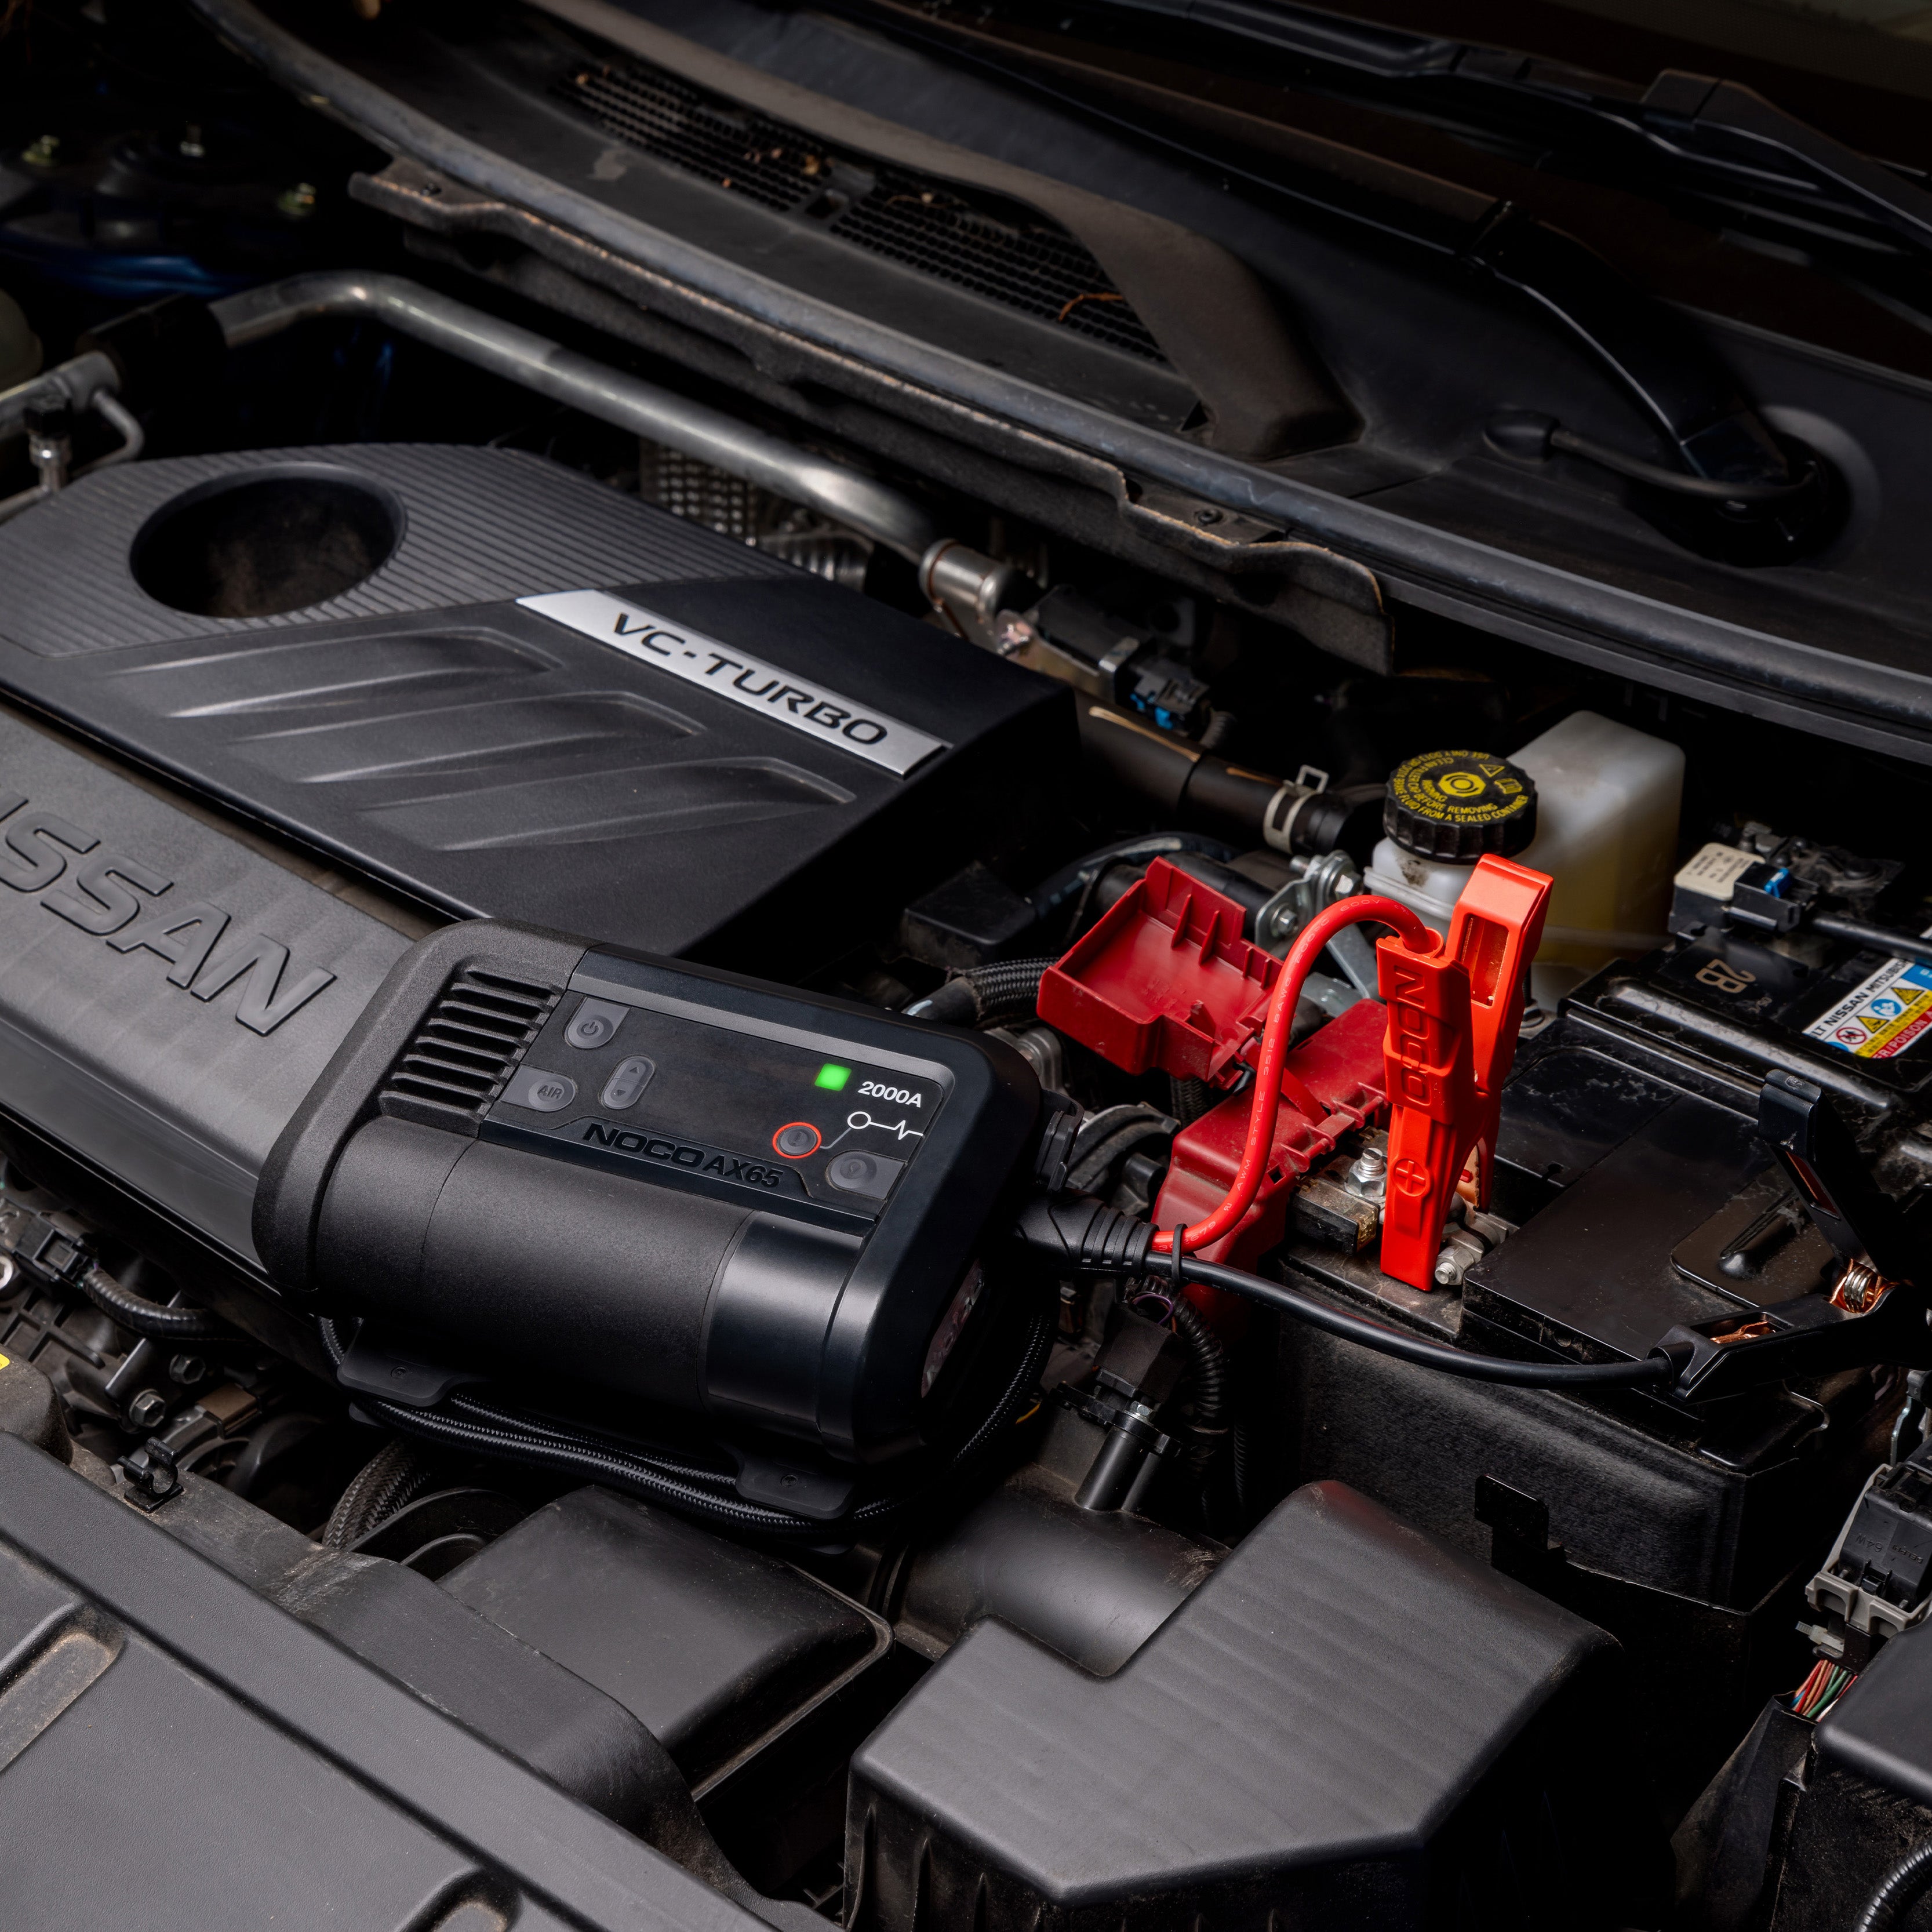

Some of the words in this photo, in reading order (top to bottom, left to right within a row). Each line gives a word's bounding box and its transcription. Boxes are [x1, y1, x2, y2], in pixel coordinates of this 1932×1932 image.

[613, 612, 888, 745] VC-TURBO
[1407, 782, 1421, 794] CAP
[1413, 792, 1447, 812] BEFORE
[1398, 794, 1421, 810] FLUID
[1417, 806, 1446, 820] FROM
[1445, 813, 1453, 821] A
[1454, 813, 1492, 823] SEALED
[1491, 794, 1529, 819] CONTAINER
[1446, 802, 1498, 814] REMOVING
[1694, 958, 1756, 994] 2B
[1824, 992, 1869, 1026] NISSAN
[1236, 1159, 1251, 1191] AWM
[1250, 1090, 1266, 1146] STYLE
[1263, 1037, 1276, 1076] 3512
[1340, 898, 1381, 912] 600V
[1393, 965, 1432, 1107] NOCO
[537, 1085, 564, 1100] AIR
[857, 1080, 922, 1108] 2000A
[583, 1122, 705, 1168] NOCO
[703, 1154, 784, 1188] AX65
[1892, 1544, 1924, 1564] DELPHI
